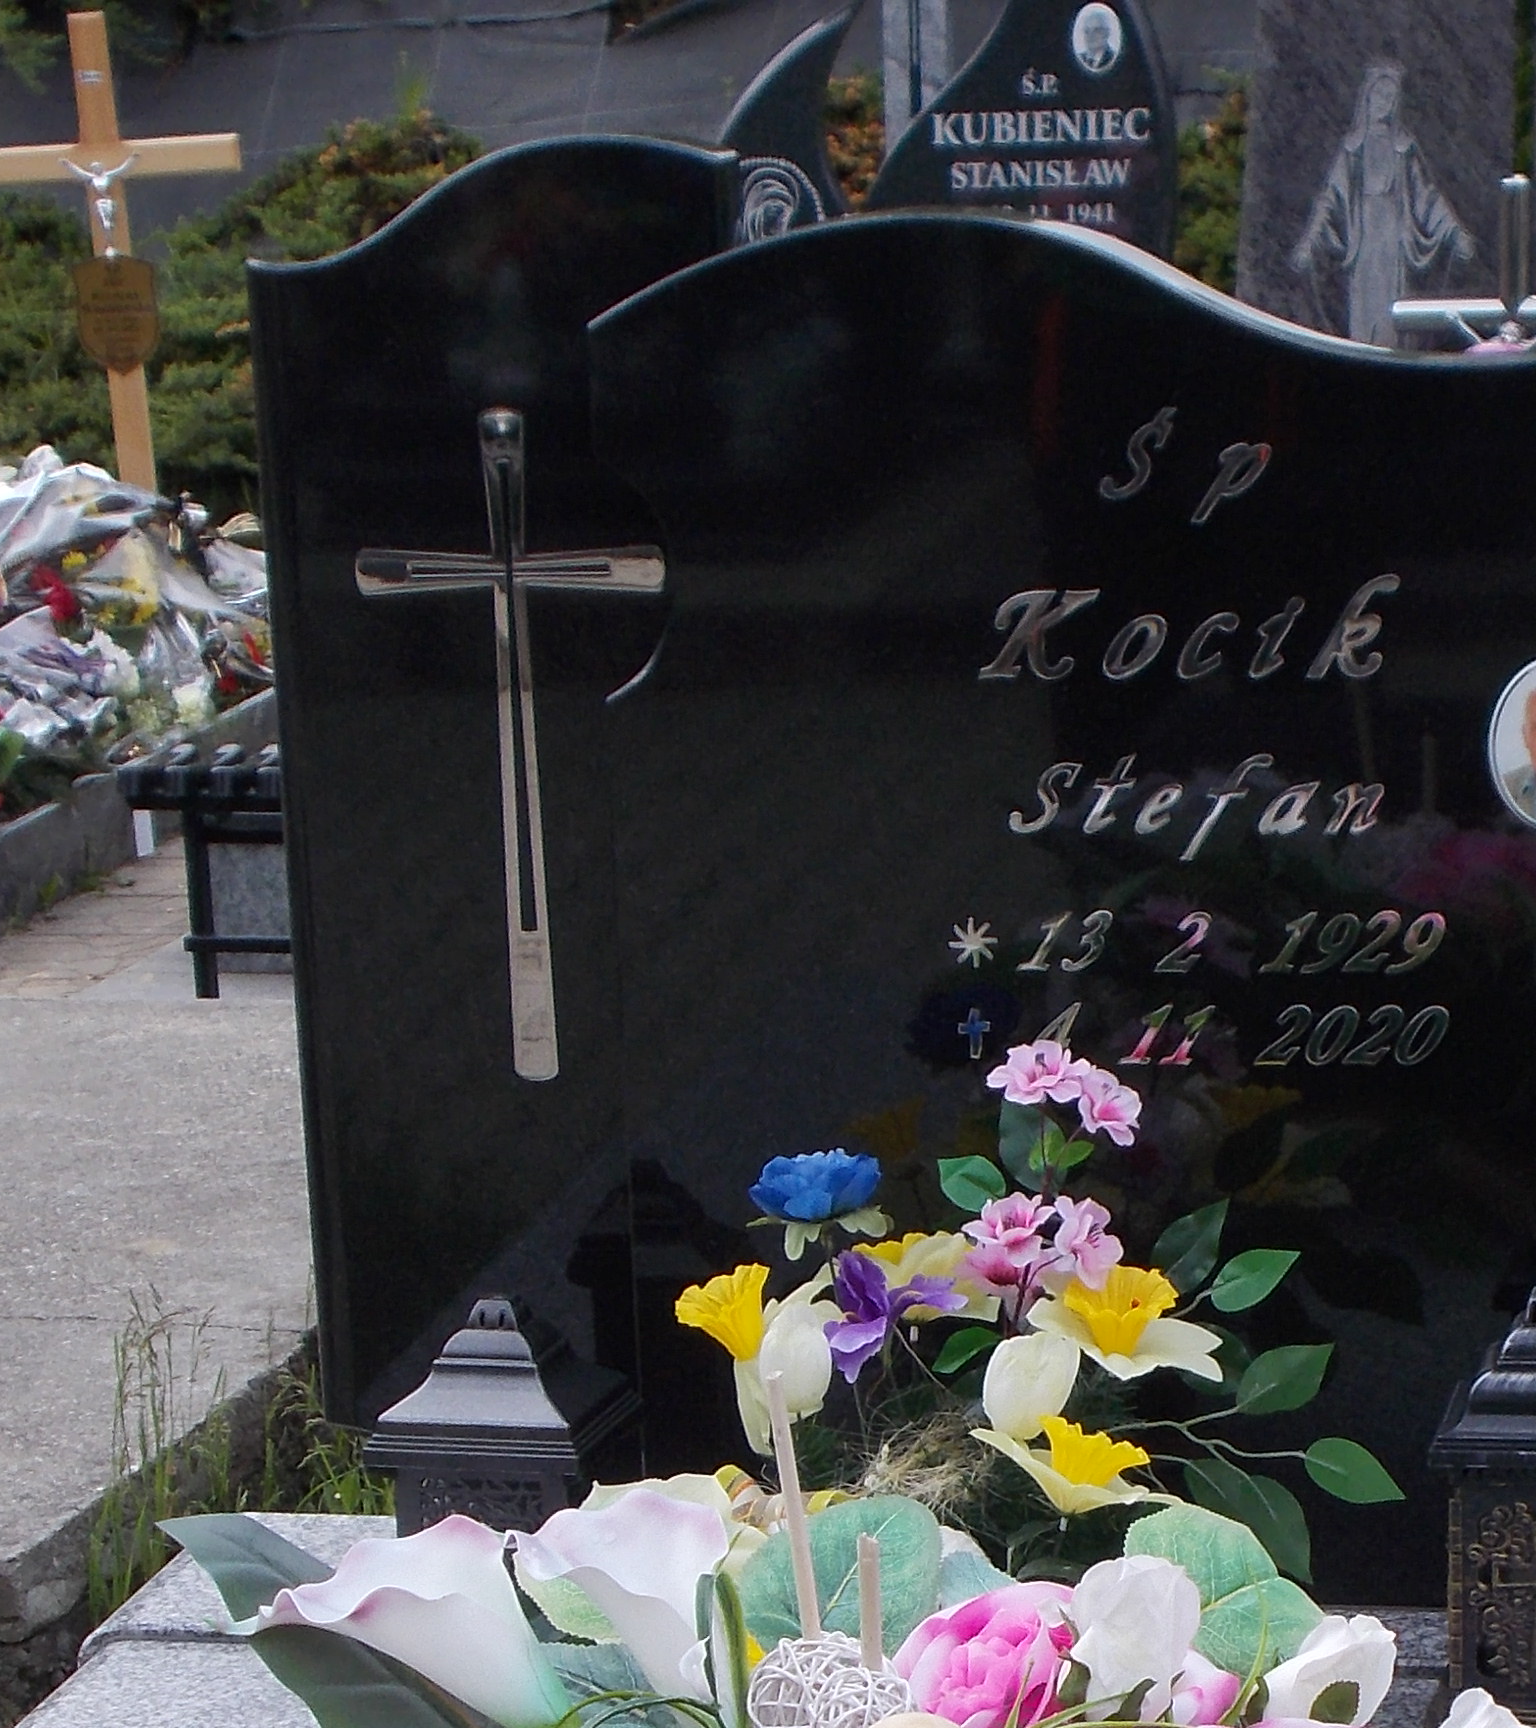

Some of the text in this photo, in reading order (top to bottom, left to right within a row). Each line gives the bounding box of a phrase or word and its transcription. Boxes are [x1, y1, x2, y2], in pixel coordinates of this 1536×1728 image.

[932, 106, 1152, 145] KUBIENIEC
[950, 157, 1132, 189] STANISŁAW
[1066, 202, 1116, 225] 1941
[978, 573, 1401, 680] Kocik
[1007, 753, 1386, 861] Stefan
[1016, 910, 1448, 975] 13 2 1929
[1116, 1002, 1217, 1066] 11
[1253, 1003, 1451, 1066] 2020
